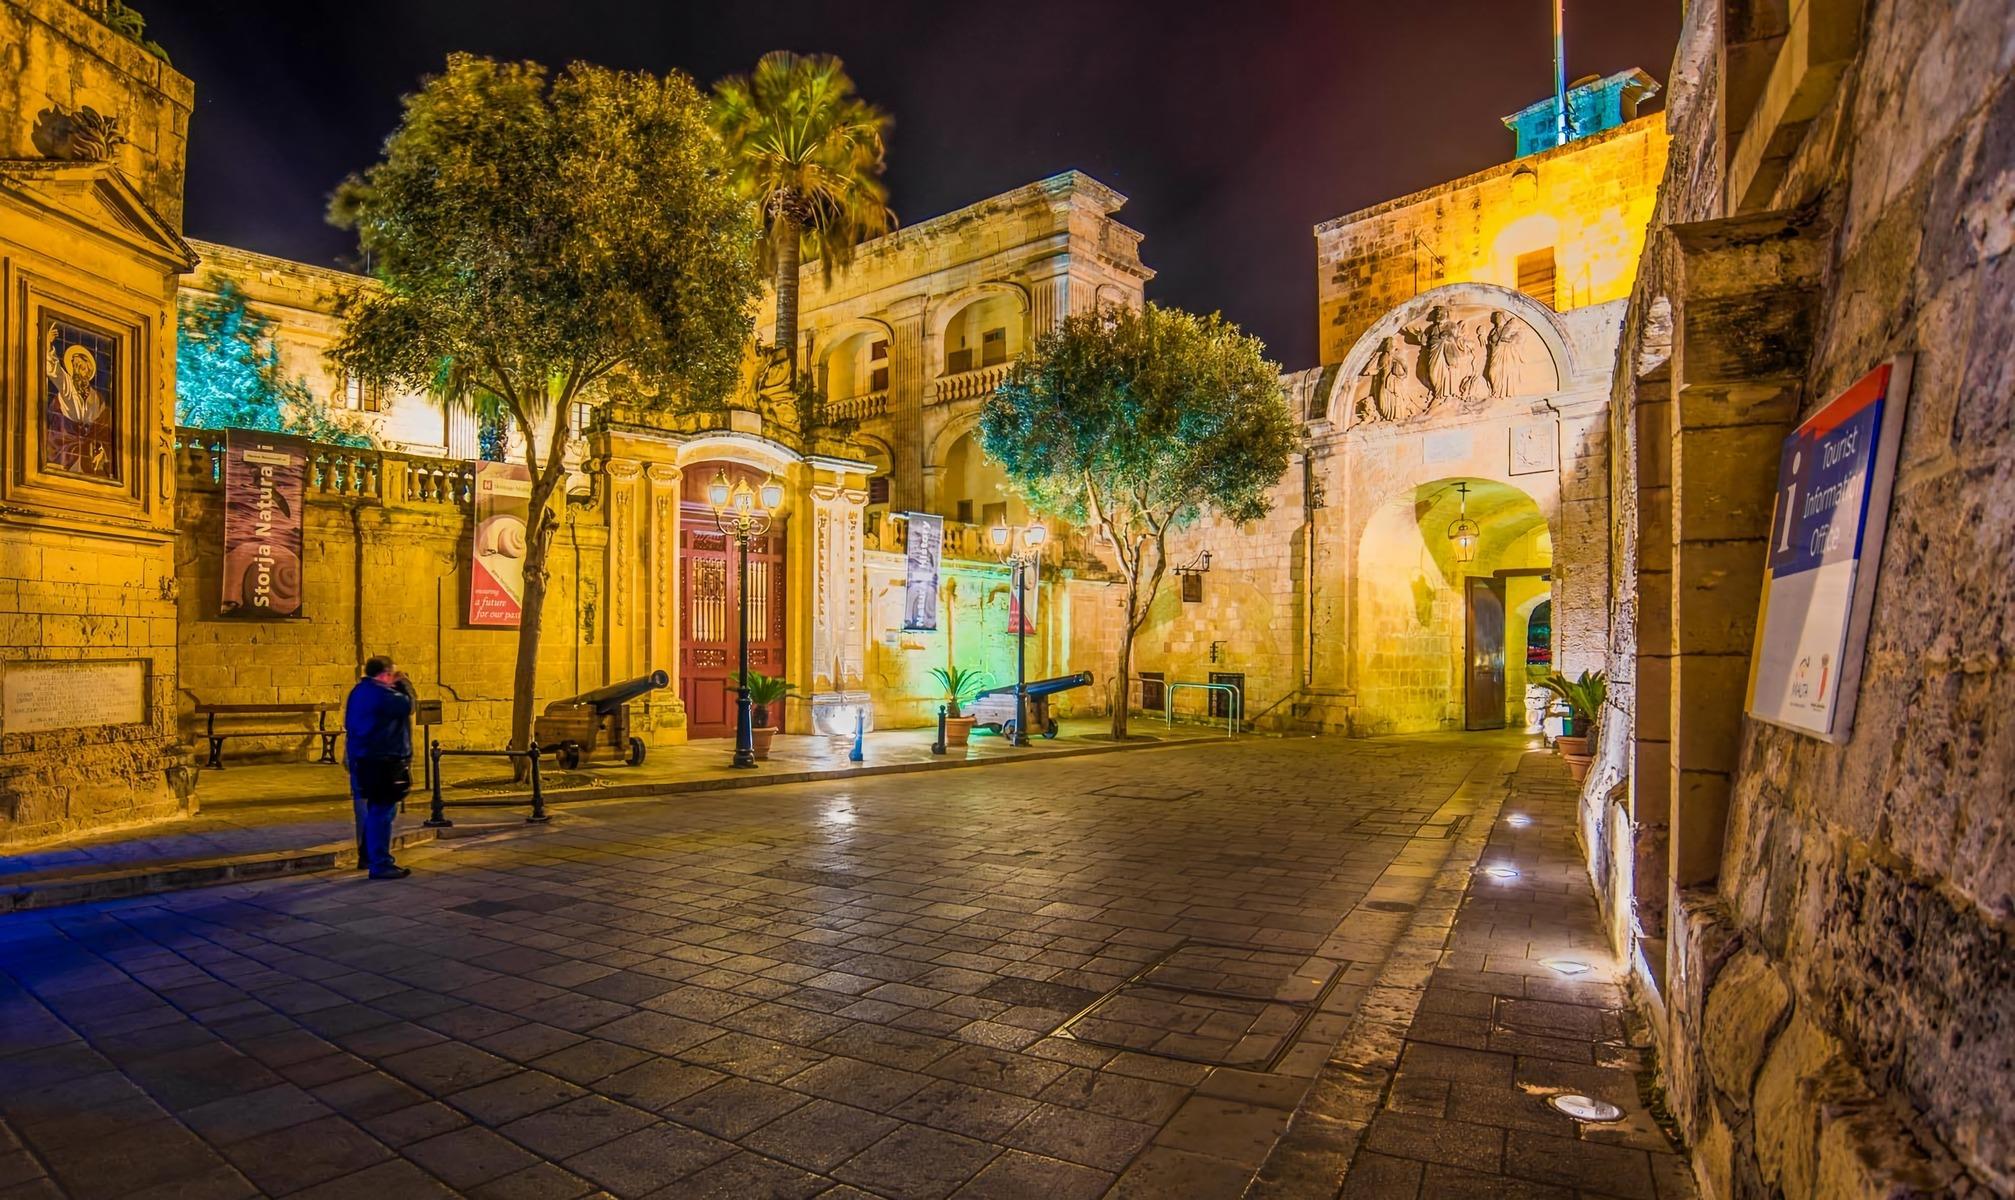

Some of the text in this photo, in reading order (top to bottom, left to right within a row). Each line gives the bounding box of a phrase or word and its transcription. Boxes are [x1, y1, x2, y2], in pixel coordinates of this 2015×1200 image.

[1822, 424, 1858, 471] Tourist
[256, 445, 274, 536] Naturai
[1804, 472, 1864, 518] Information
[1810, 523, 1840, 557] Office
[254, 545, 275, 608] Storja
[474, 608, 489, 622] for
